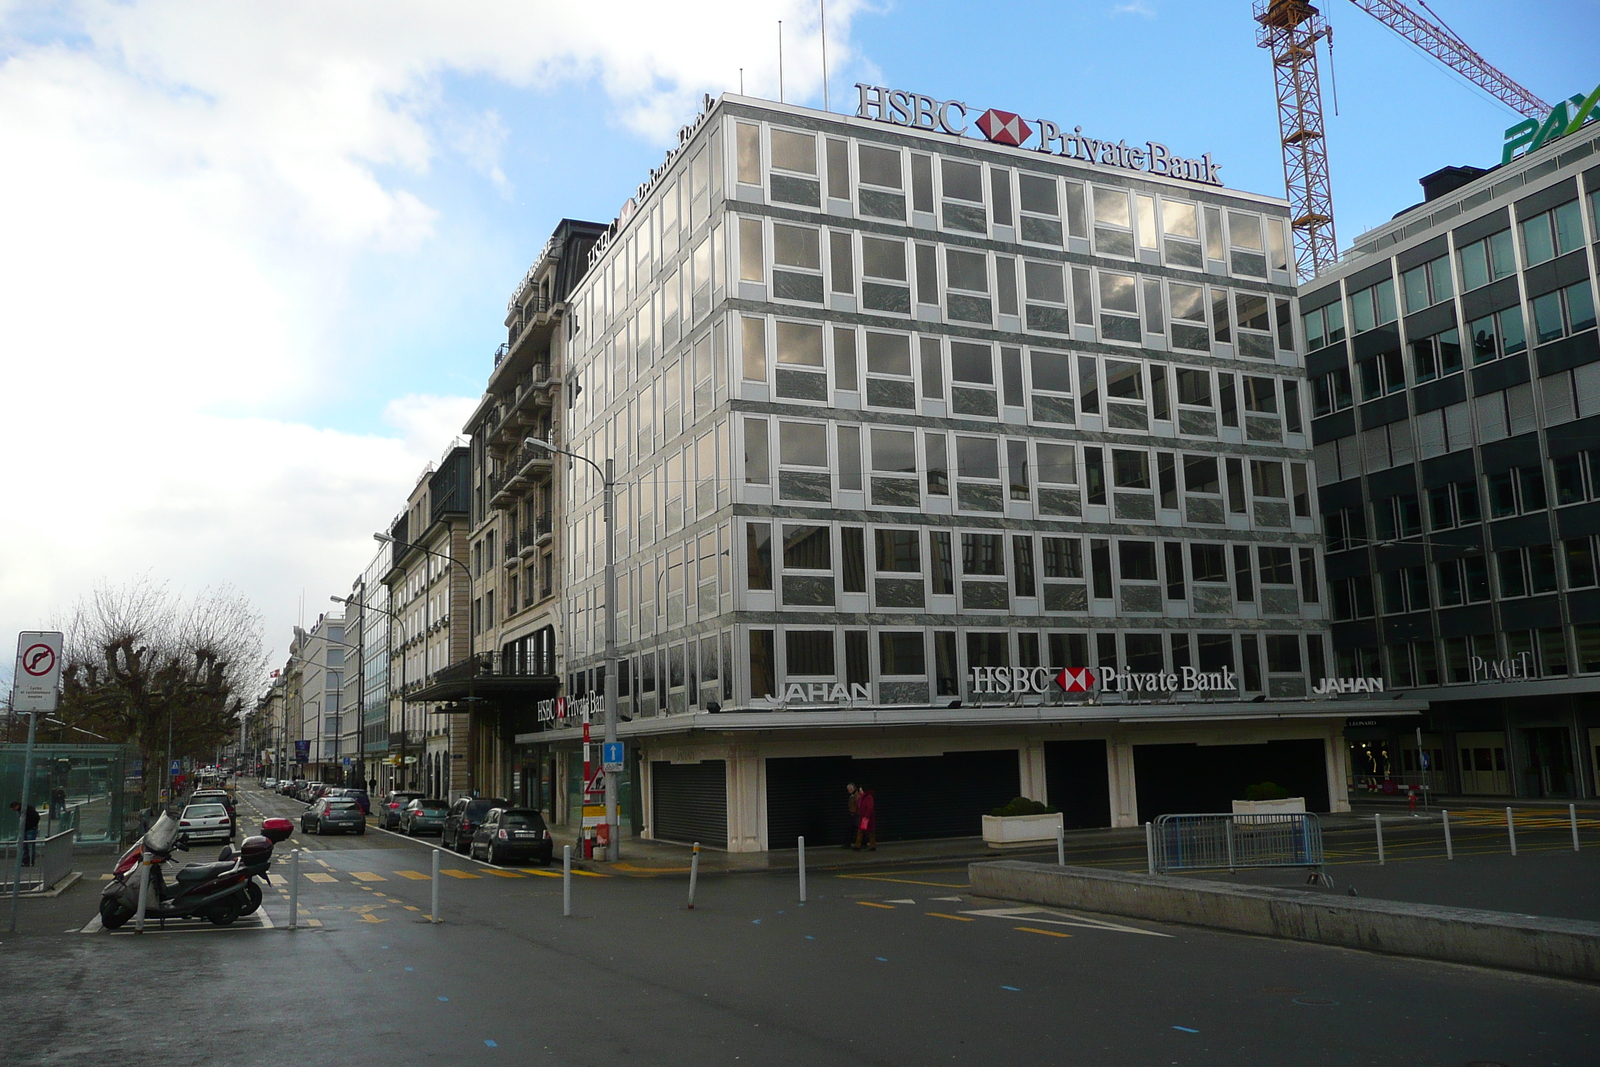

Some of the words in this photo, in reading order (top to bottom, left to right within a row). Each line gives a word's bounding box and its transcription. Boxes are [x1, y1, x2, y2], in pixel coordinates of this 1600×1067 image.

[855, 82, 968, 136] HSBC
[1037, 118, 1146, 171] Private
[1146, 140, 1225, 187] Bank
[972, 666, 1050, 694] HSBC
[1100, 665, 1178, 693] Private
[1180, 665, 1237, 692] Bank
[1471, 651, 1531, 683] PIAGET
[764, 682, 873, 703] JAHAN
[1312, 677, 1384, 694] JAHAN
[537, 699, 556, 722] HSBC
[589, 690, 605, 715] Ban
